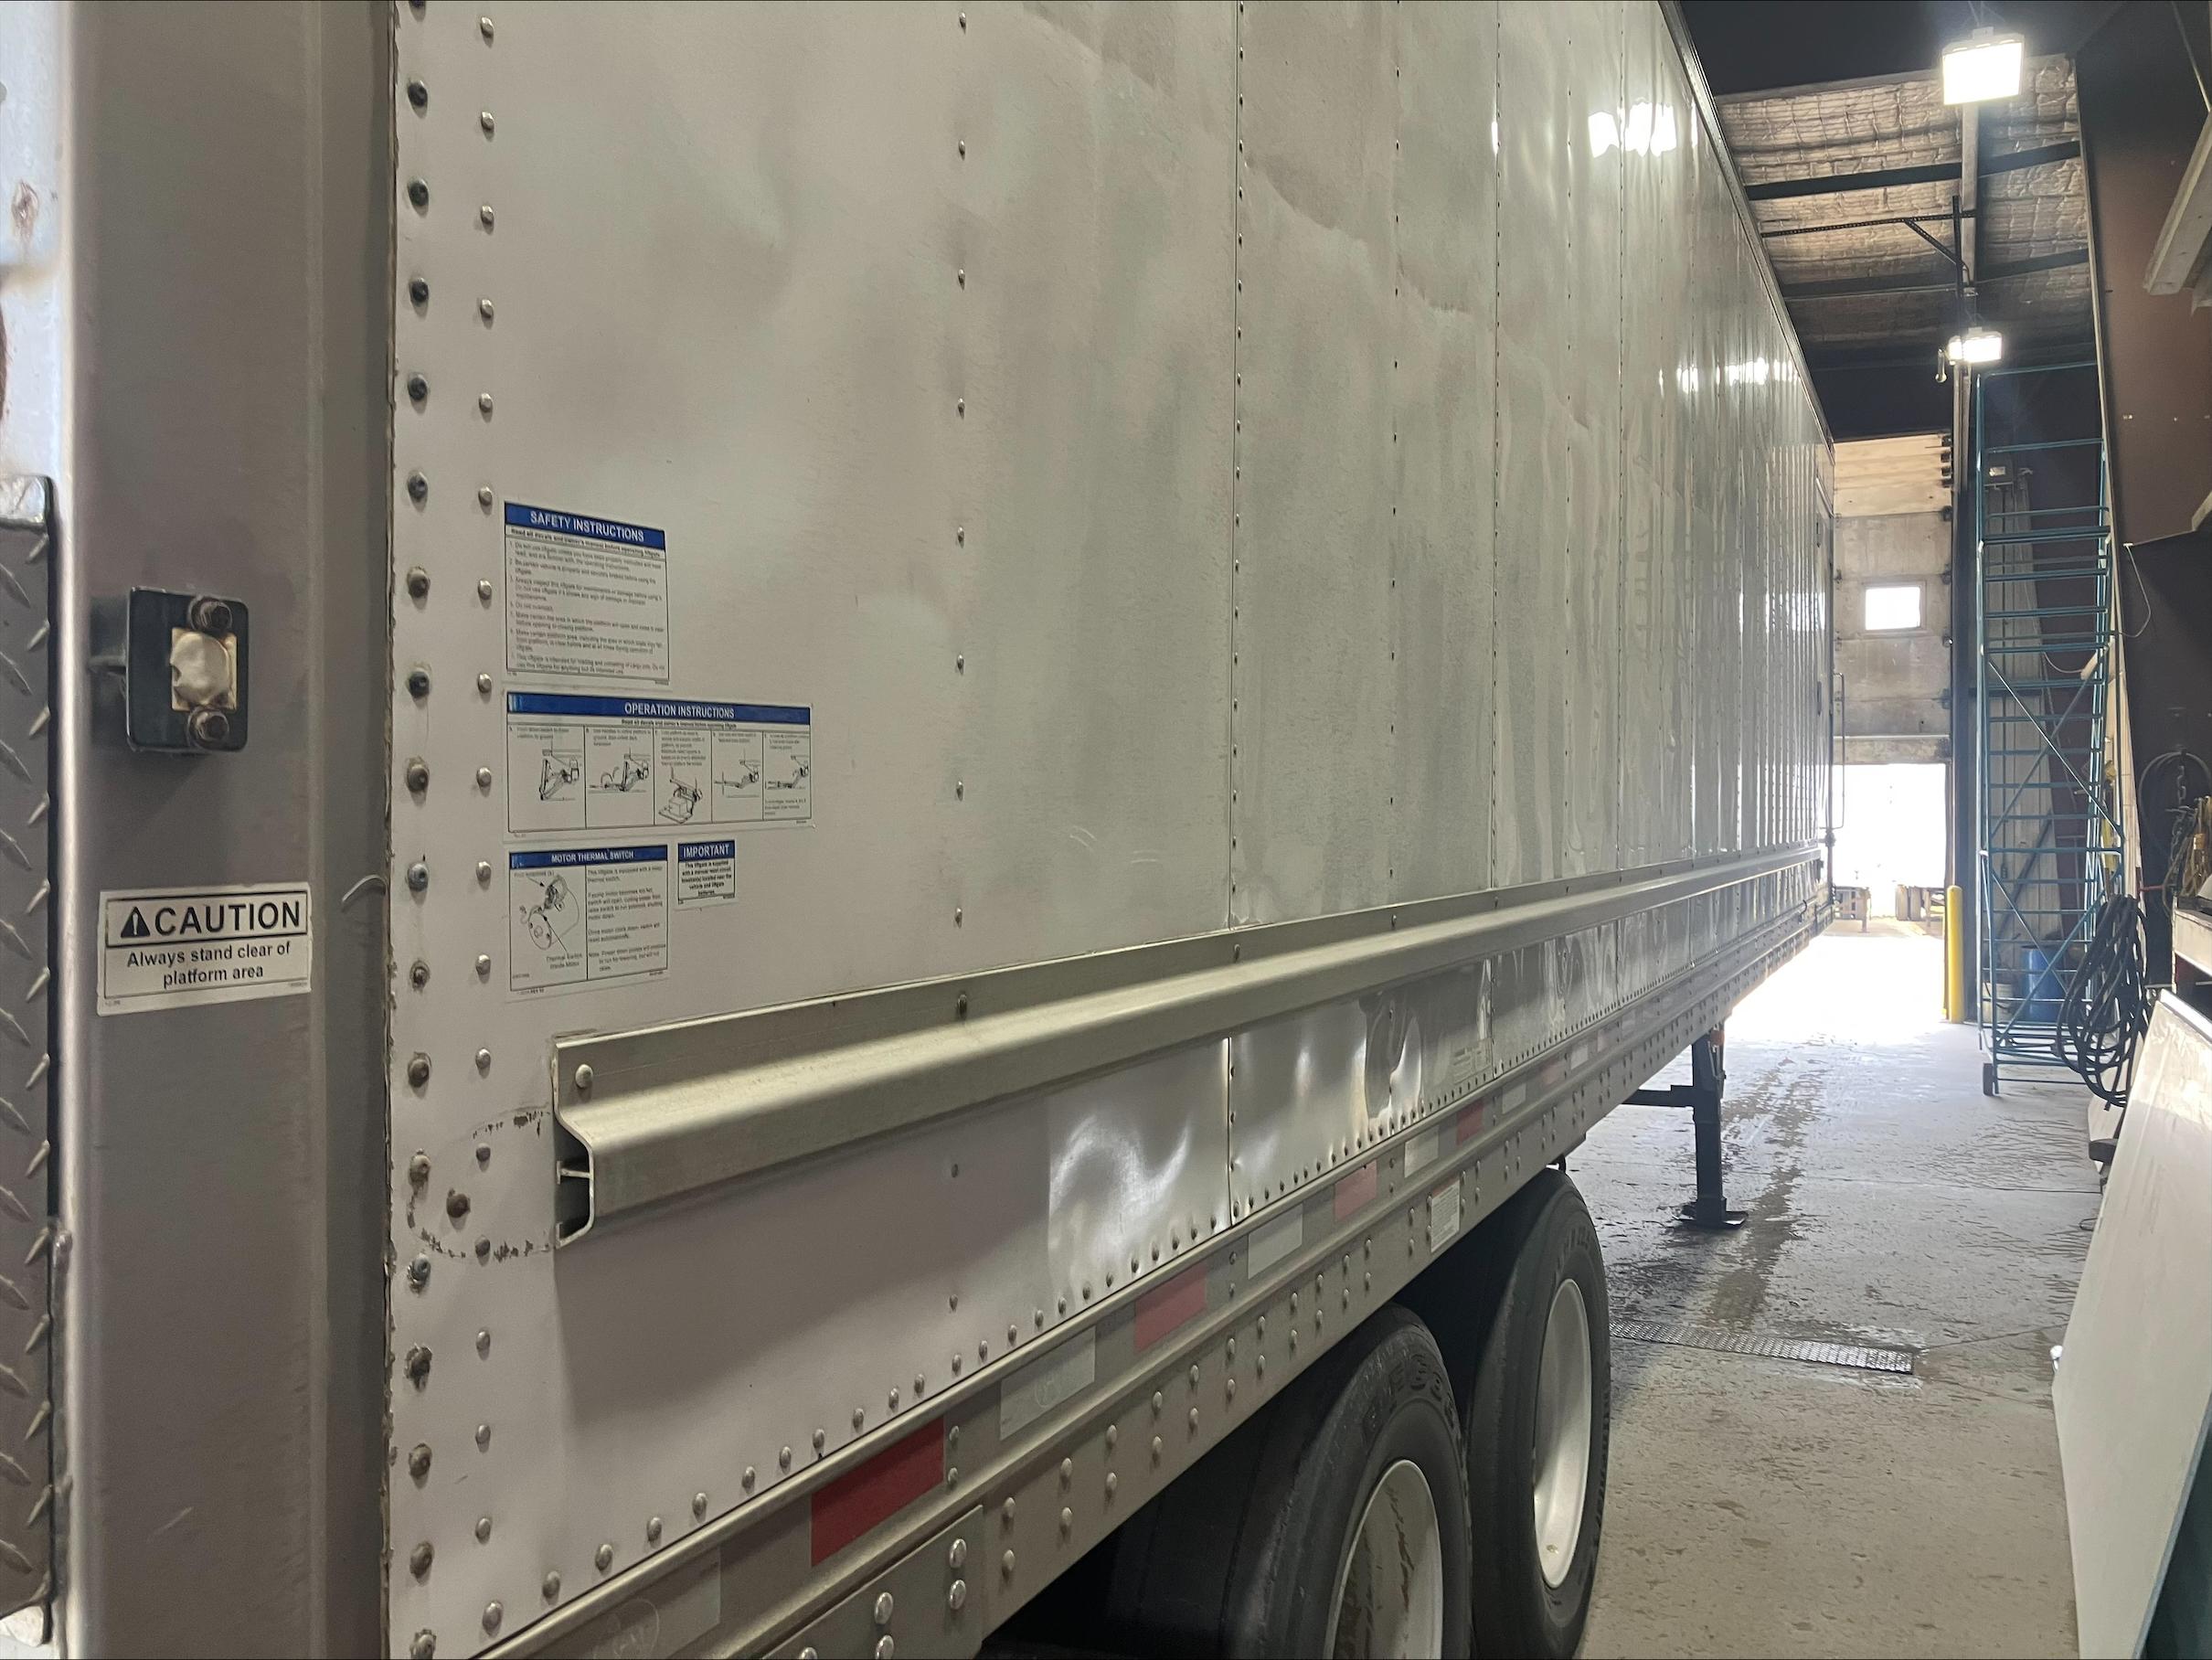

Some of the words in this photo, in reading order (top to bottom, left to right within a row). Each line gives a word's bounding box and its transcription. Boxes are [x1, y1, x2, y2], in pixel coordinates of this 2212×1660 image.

[530, 510, 570, 529] SAFETY
[573, 519, 644, 542] INSTRUCTIONS
[624, 702, 676, 716] OPERATION
[678, 705, 735, 718] INSTRUCTIONS
[551, 854, 576, 864] MOTOR
[578, 852, 609, 862] THERMAL
[610, 850, 634, 860] SWITCH
[684, 844, 729, 858] IMPORTANT
[154, 900, 300, 937] CAUTION
[127, 952, 186, 969] Always
[191, 945, 232, 963] stand
[238, 942, 272, 959] clear
[277, 941, 291, 954] of
[164, 967, 227, 989] platform
[233, 965, 263, 980] area
